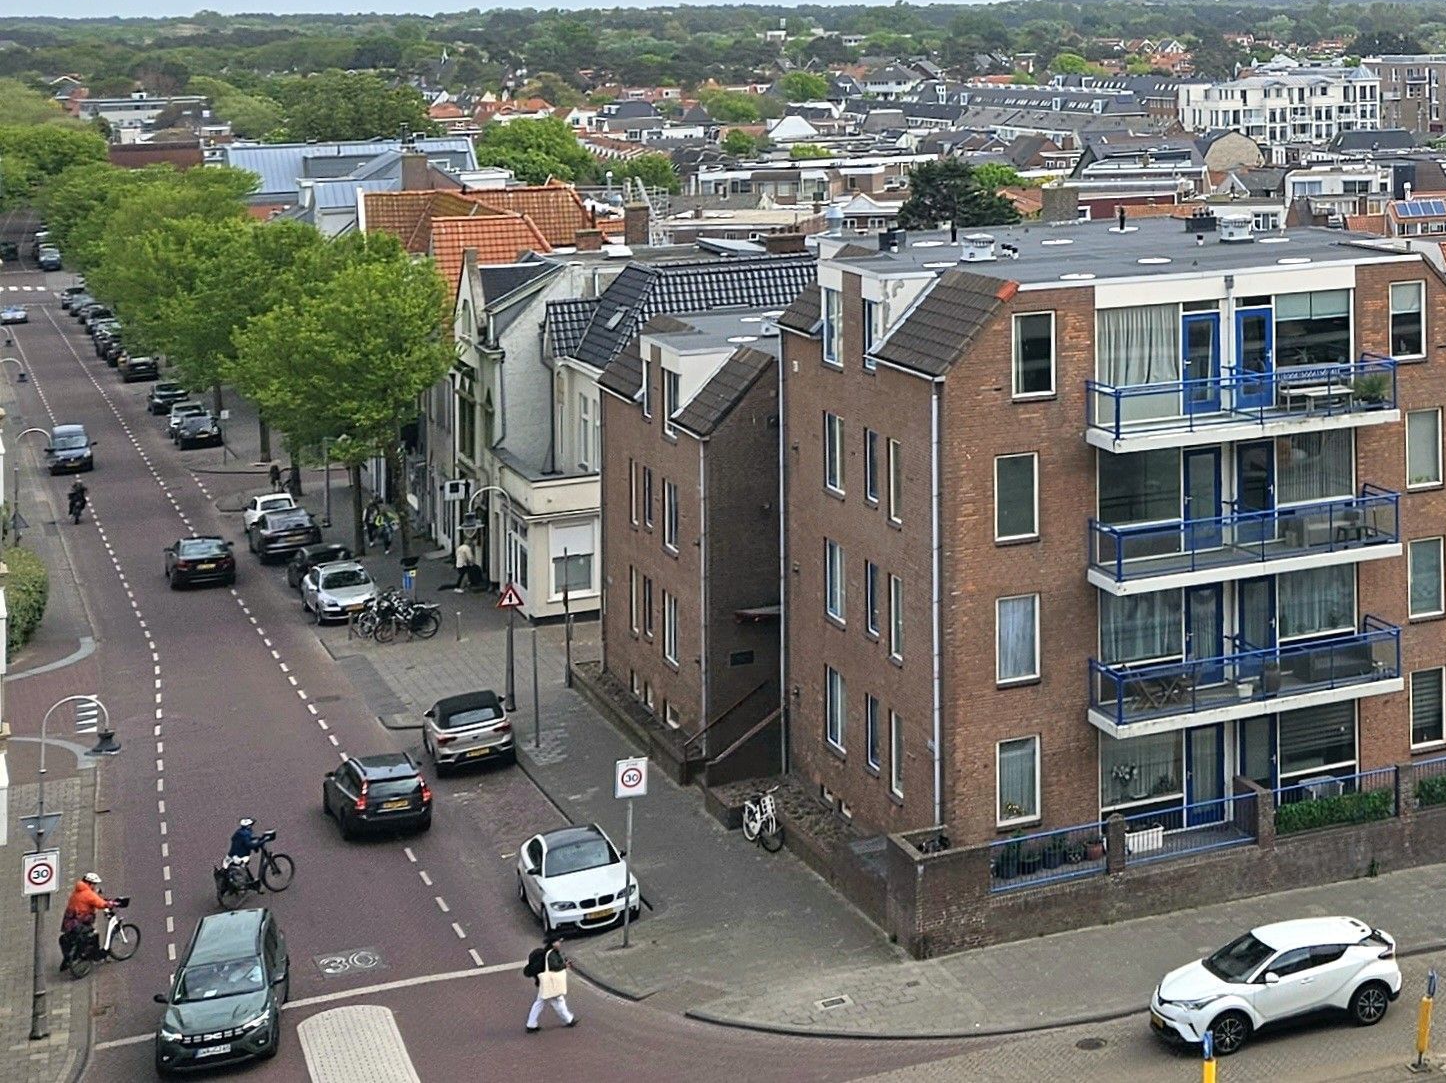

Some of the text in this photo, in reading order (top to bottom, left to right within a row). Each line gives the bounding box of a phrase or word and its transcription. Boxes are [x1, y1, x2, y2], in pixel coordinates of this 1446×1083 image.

[625, 773, 639, 783] 30
[33, 869, 49, 880] 30
[320, 951, 379, 974] 30
